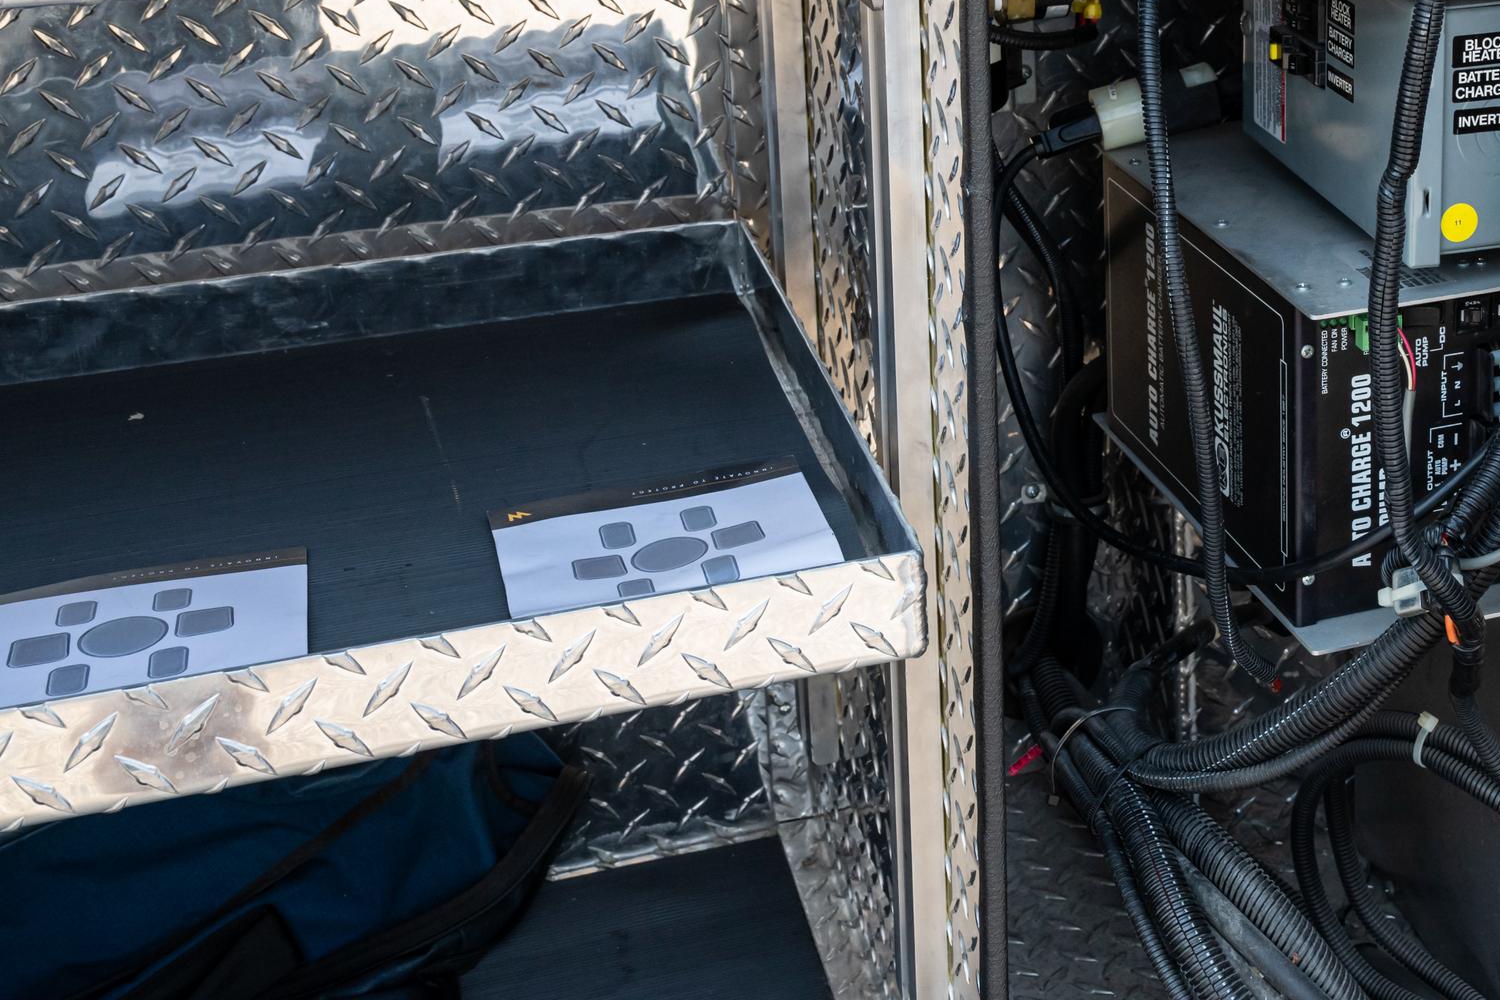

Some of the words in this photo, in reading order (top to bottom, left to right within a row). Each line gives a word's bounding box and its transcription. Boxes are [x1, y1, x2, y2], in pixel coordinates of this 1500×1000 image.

[1330, 7, 1352, 29] HEATER
[1328, 26, 1353, 50] BATTERY
[1327, 40, 1354, 67] CHARGER
[1327, 70, 1353, 95] INVERTER
[1145, 222, 1156, 281] 1200
[1146, 289, 1158, 382] CHARGE
[1331, 328, 1338, 339] ON
[1439, 326, 1446, 344] DC
[1321, 330, 1329, 367] CONNECTED
[1212, 304, 1225, 435] KUSSMAUL
[1220, 308, 1229, 442] ELECTRONICS
[1321, 368, 1329, 395] BATTERY
[1454, 381, 1461, 389] N
[1351, 373, 1372, 428] 1200
[1149, 385, 1159, 447] AUTO
[1437, 433, 1445, 449] COM
[714, 465, 774, 481] INNOVATE
[1426, 450, 1434, 491] OUTPUT
[631, 483, 685, 496] PROTECT
[1351, 516, 1372, 567] ATO
